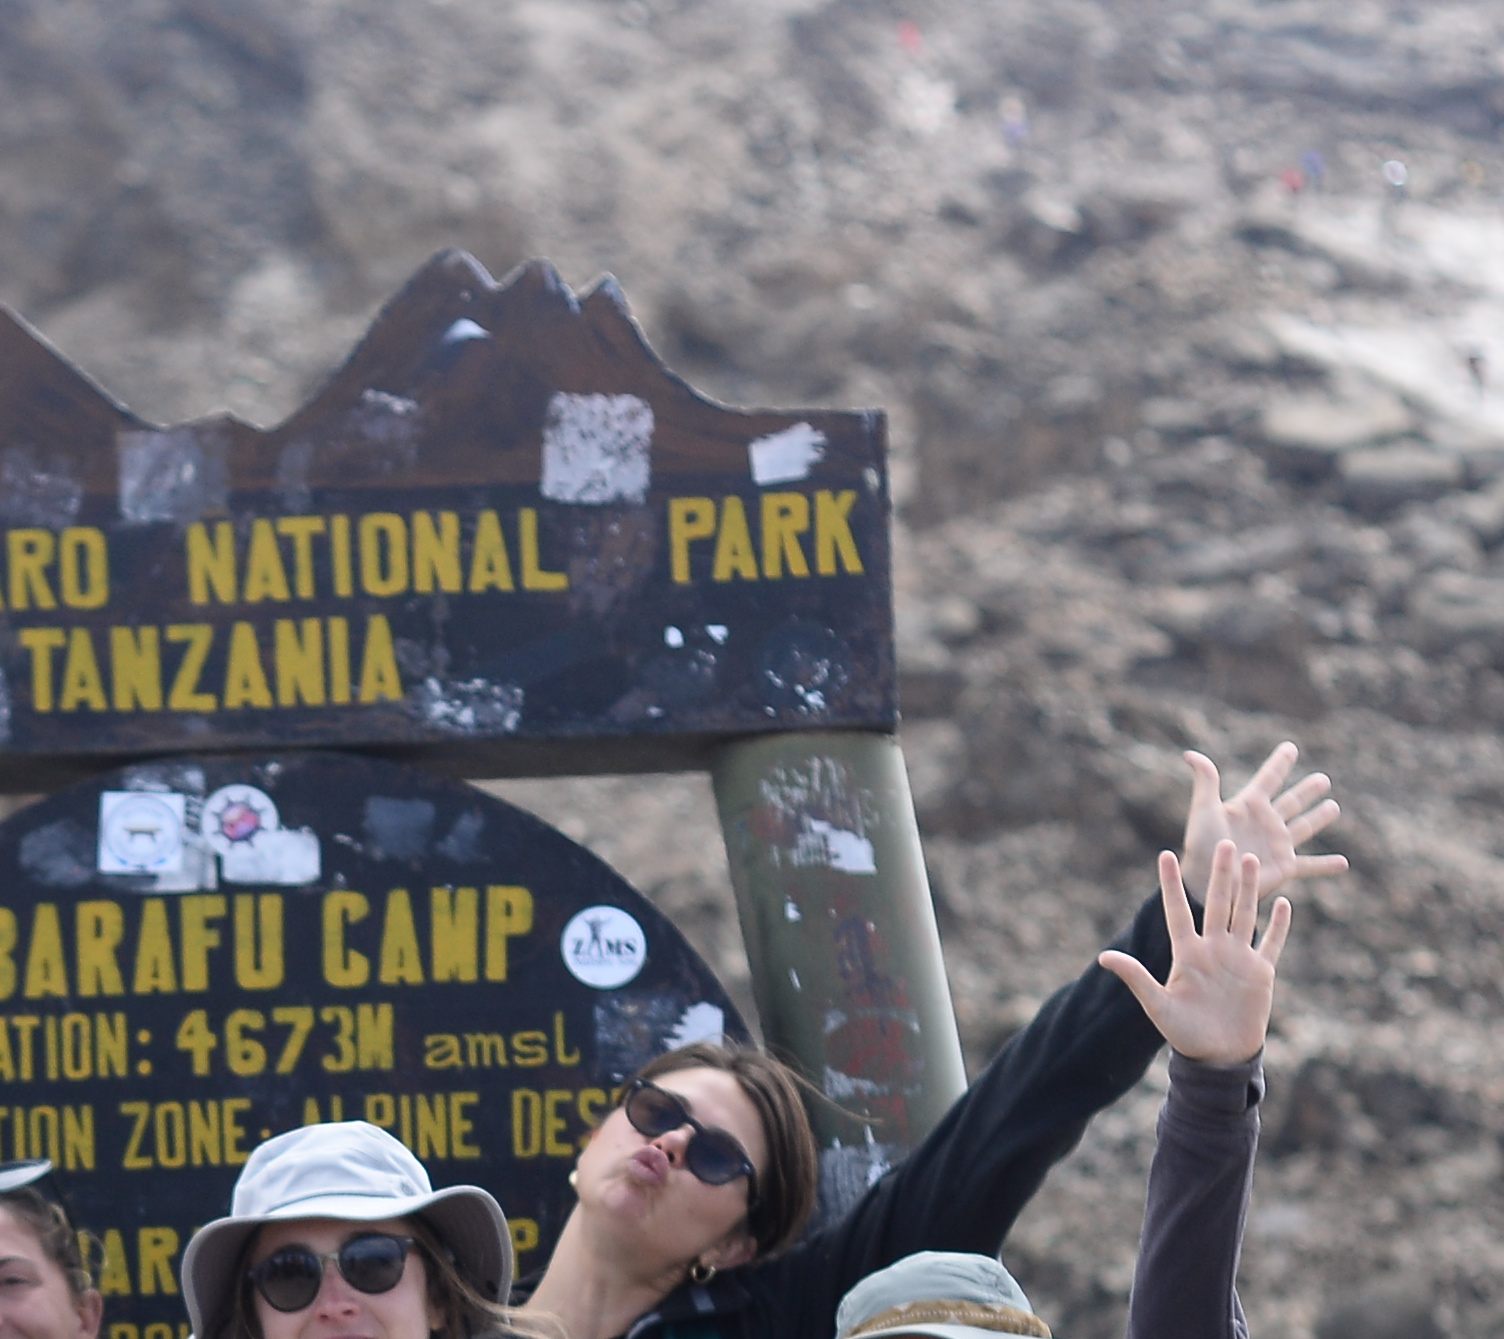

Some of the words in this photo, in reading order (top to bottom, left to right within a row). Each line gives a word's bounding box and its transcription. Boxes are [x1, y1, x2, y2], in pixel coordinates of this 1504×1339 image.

[187, 508, 569, 606] NATIONAL
[669, 489, 863, 584] PARK
[18, 614, 404, 714] TANZANIA
[322, 884, 535, 990] CAMP
[175, 1003, 395, 1077] 4673M
[424, 1015, 582, 1070] amsl
